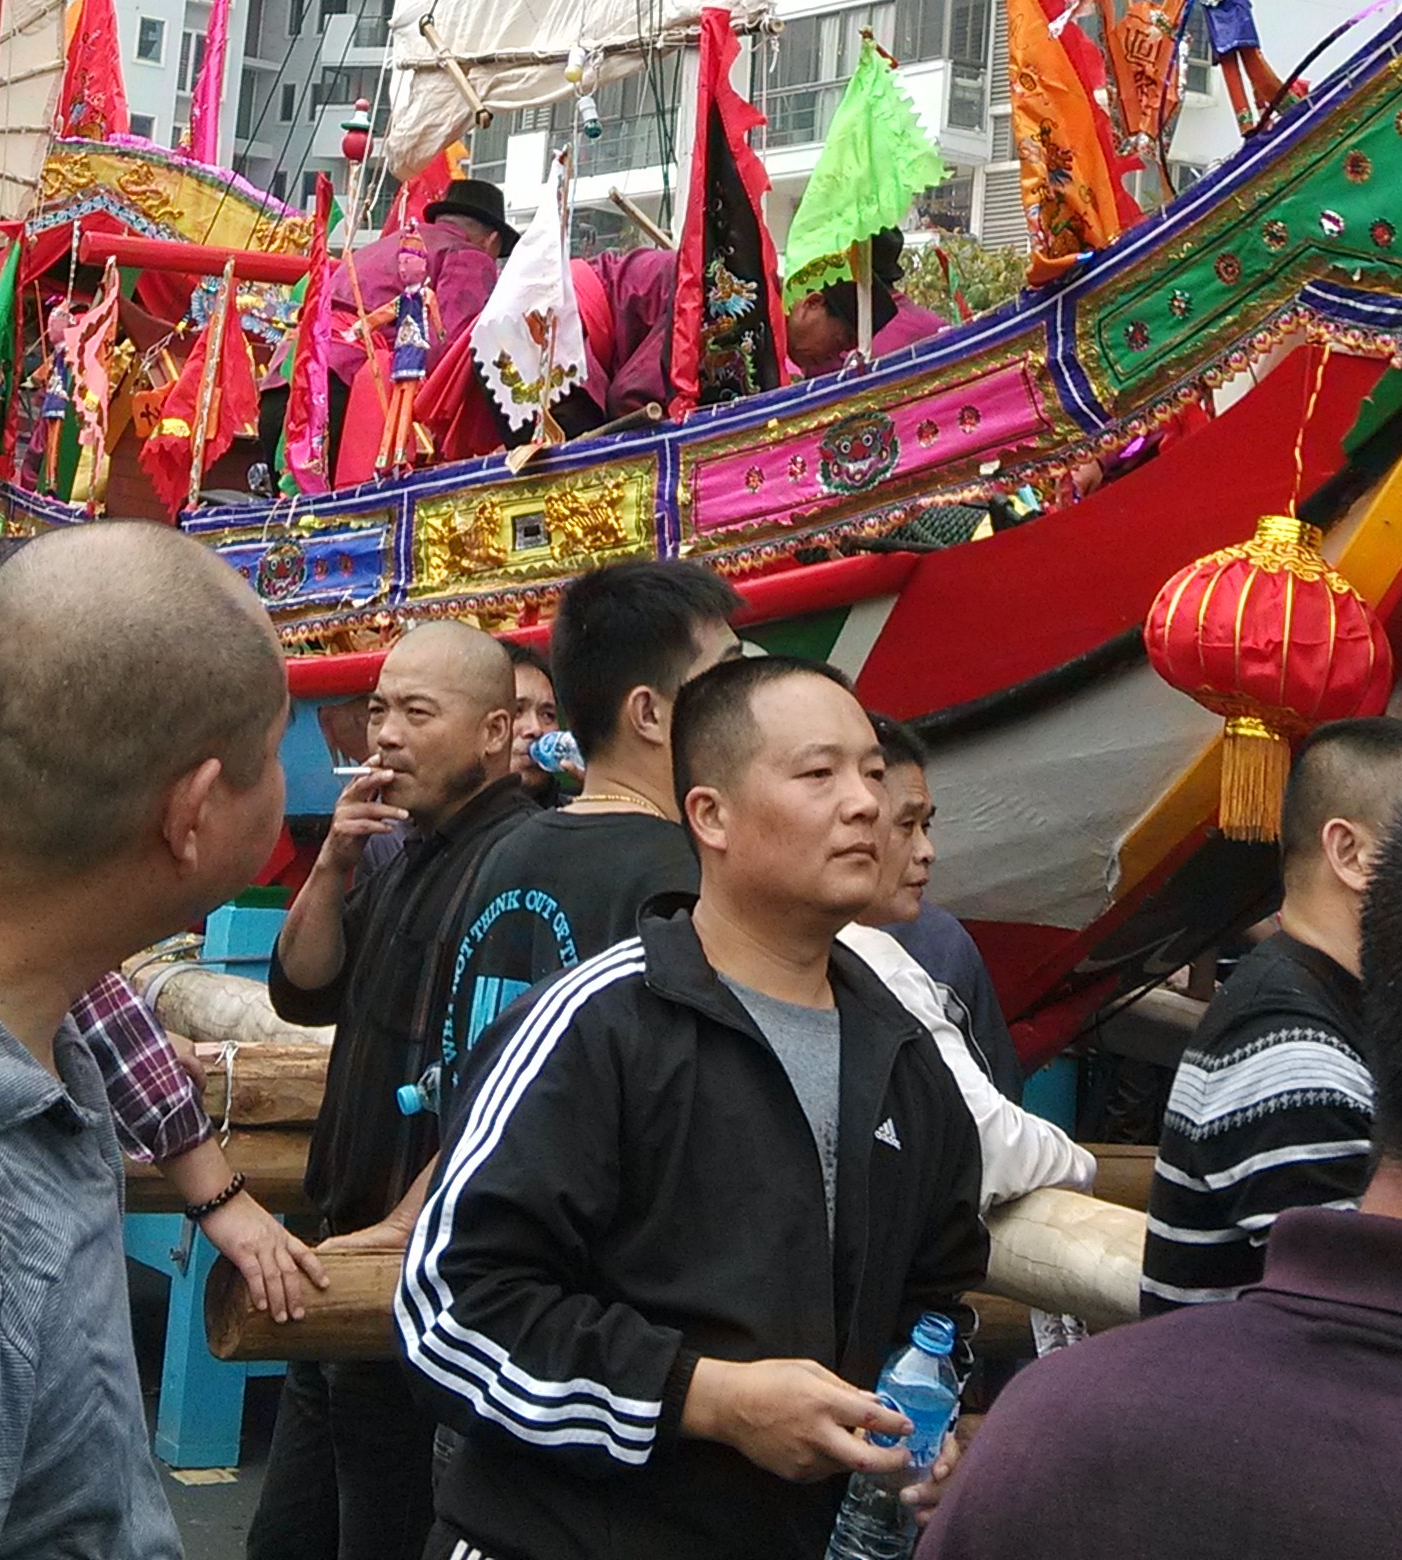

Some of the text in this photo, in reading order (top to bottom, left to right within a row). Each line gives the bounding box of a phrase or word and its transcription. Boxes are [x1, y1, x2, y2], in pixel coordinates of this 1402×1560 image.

[469, 888, 523, 944] THINK
[524, 889, 558, 921] OUT
[552, 910, 571, 943] OF
